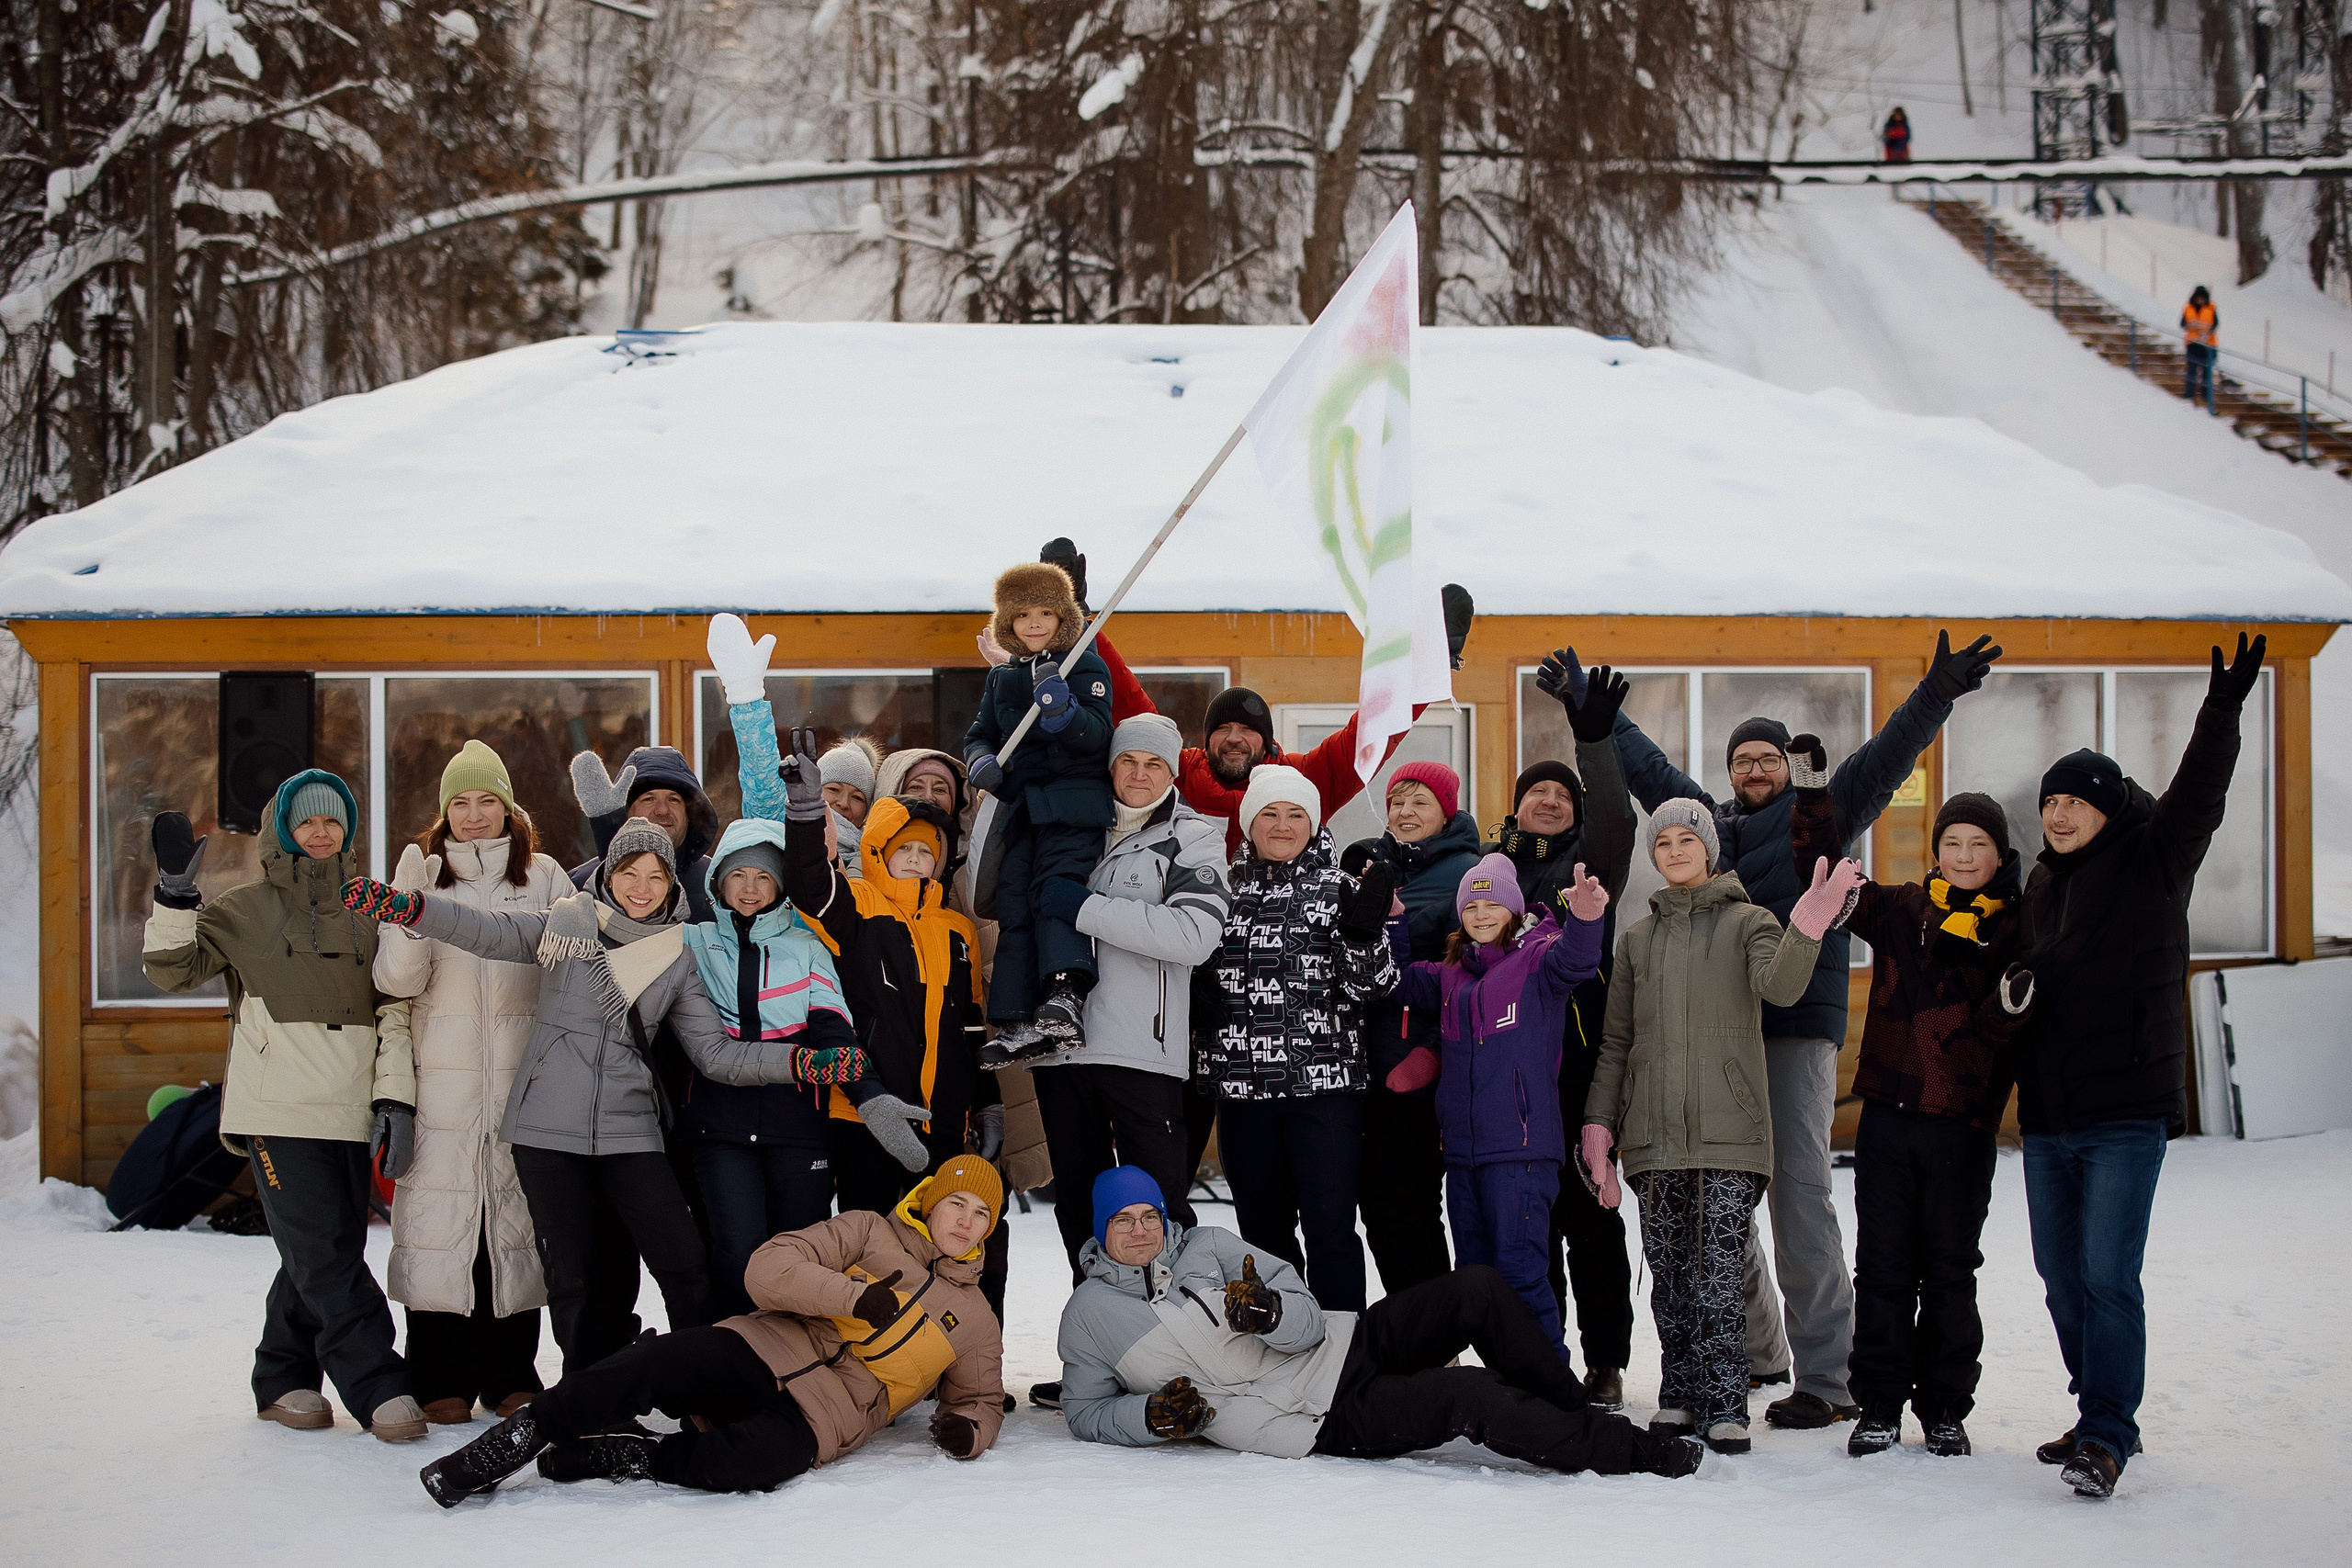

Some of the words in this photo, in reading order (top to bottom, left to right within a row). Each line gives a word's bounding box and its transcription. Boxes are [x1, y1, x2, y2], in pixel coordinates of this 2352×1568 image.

[1250, 935, 1283, 949] FILA
[1249, 991, 1284, 1005] FILA
[1292, 1038, 1313, 1046] FILA
[1211, 1054, 1228, 1062] FILA
[1251, 1049, 1288, 1063] FILA
[1311, 1076, 1345, 1091] FILA
[259, 1150, 279, 1187] BTLN
